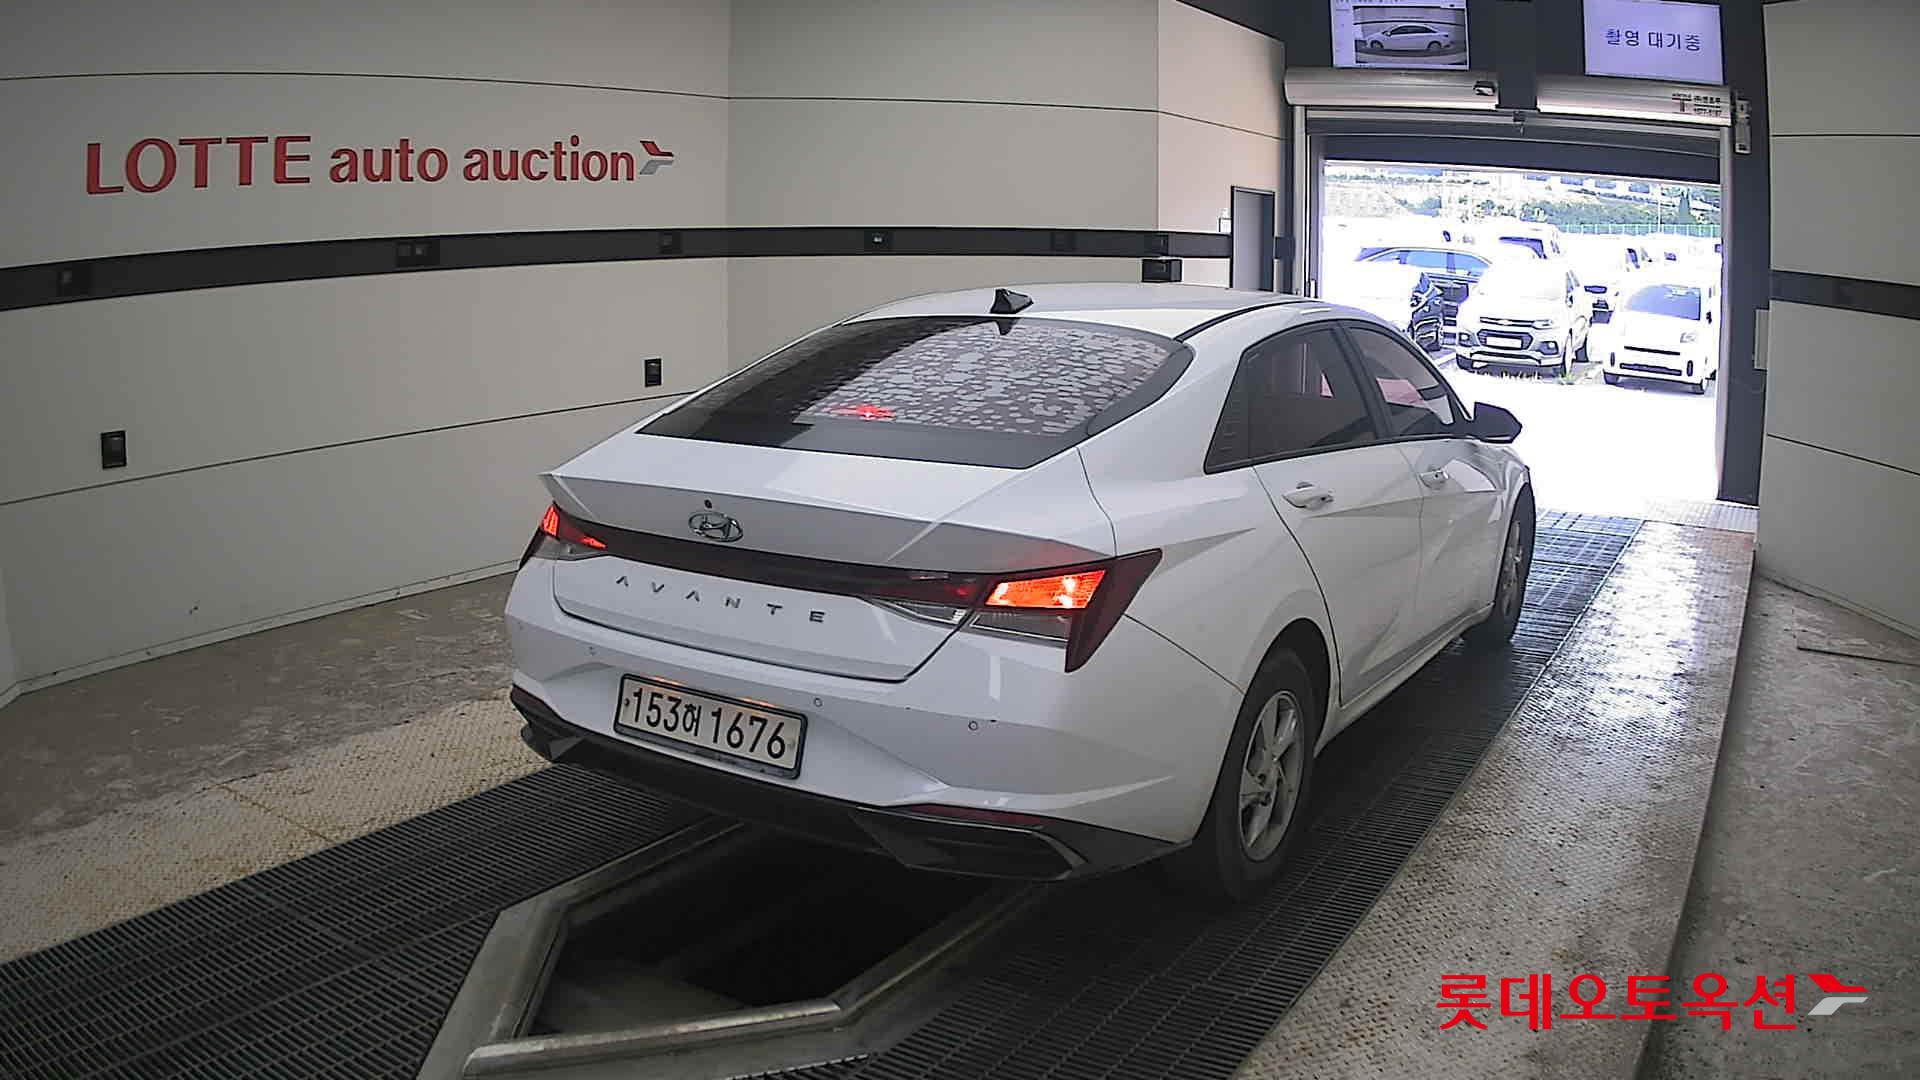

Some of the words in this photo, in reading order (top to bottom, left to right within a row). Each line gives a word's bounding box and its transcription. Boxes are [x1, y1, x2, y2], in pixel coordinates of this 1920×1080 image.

[1648, 31, 1701, 52] 대기중
[86, 135, 311, 195] LOTTE
[329, 137, 449, 184] auto
[463, 134, 636, 182] auction
[615, 575, 826, 624] AVANTE
[711, 706, 786, 760] 1676
